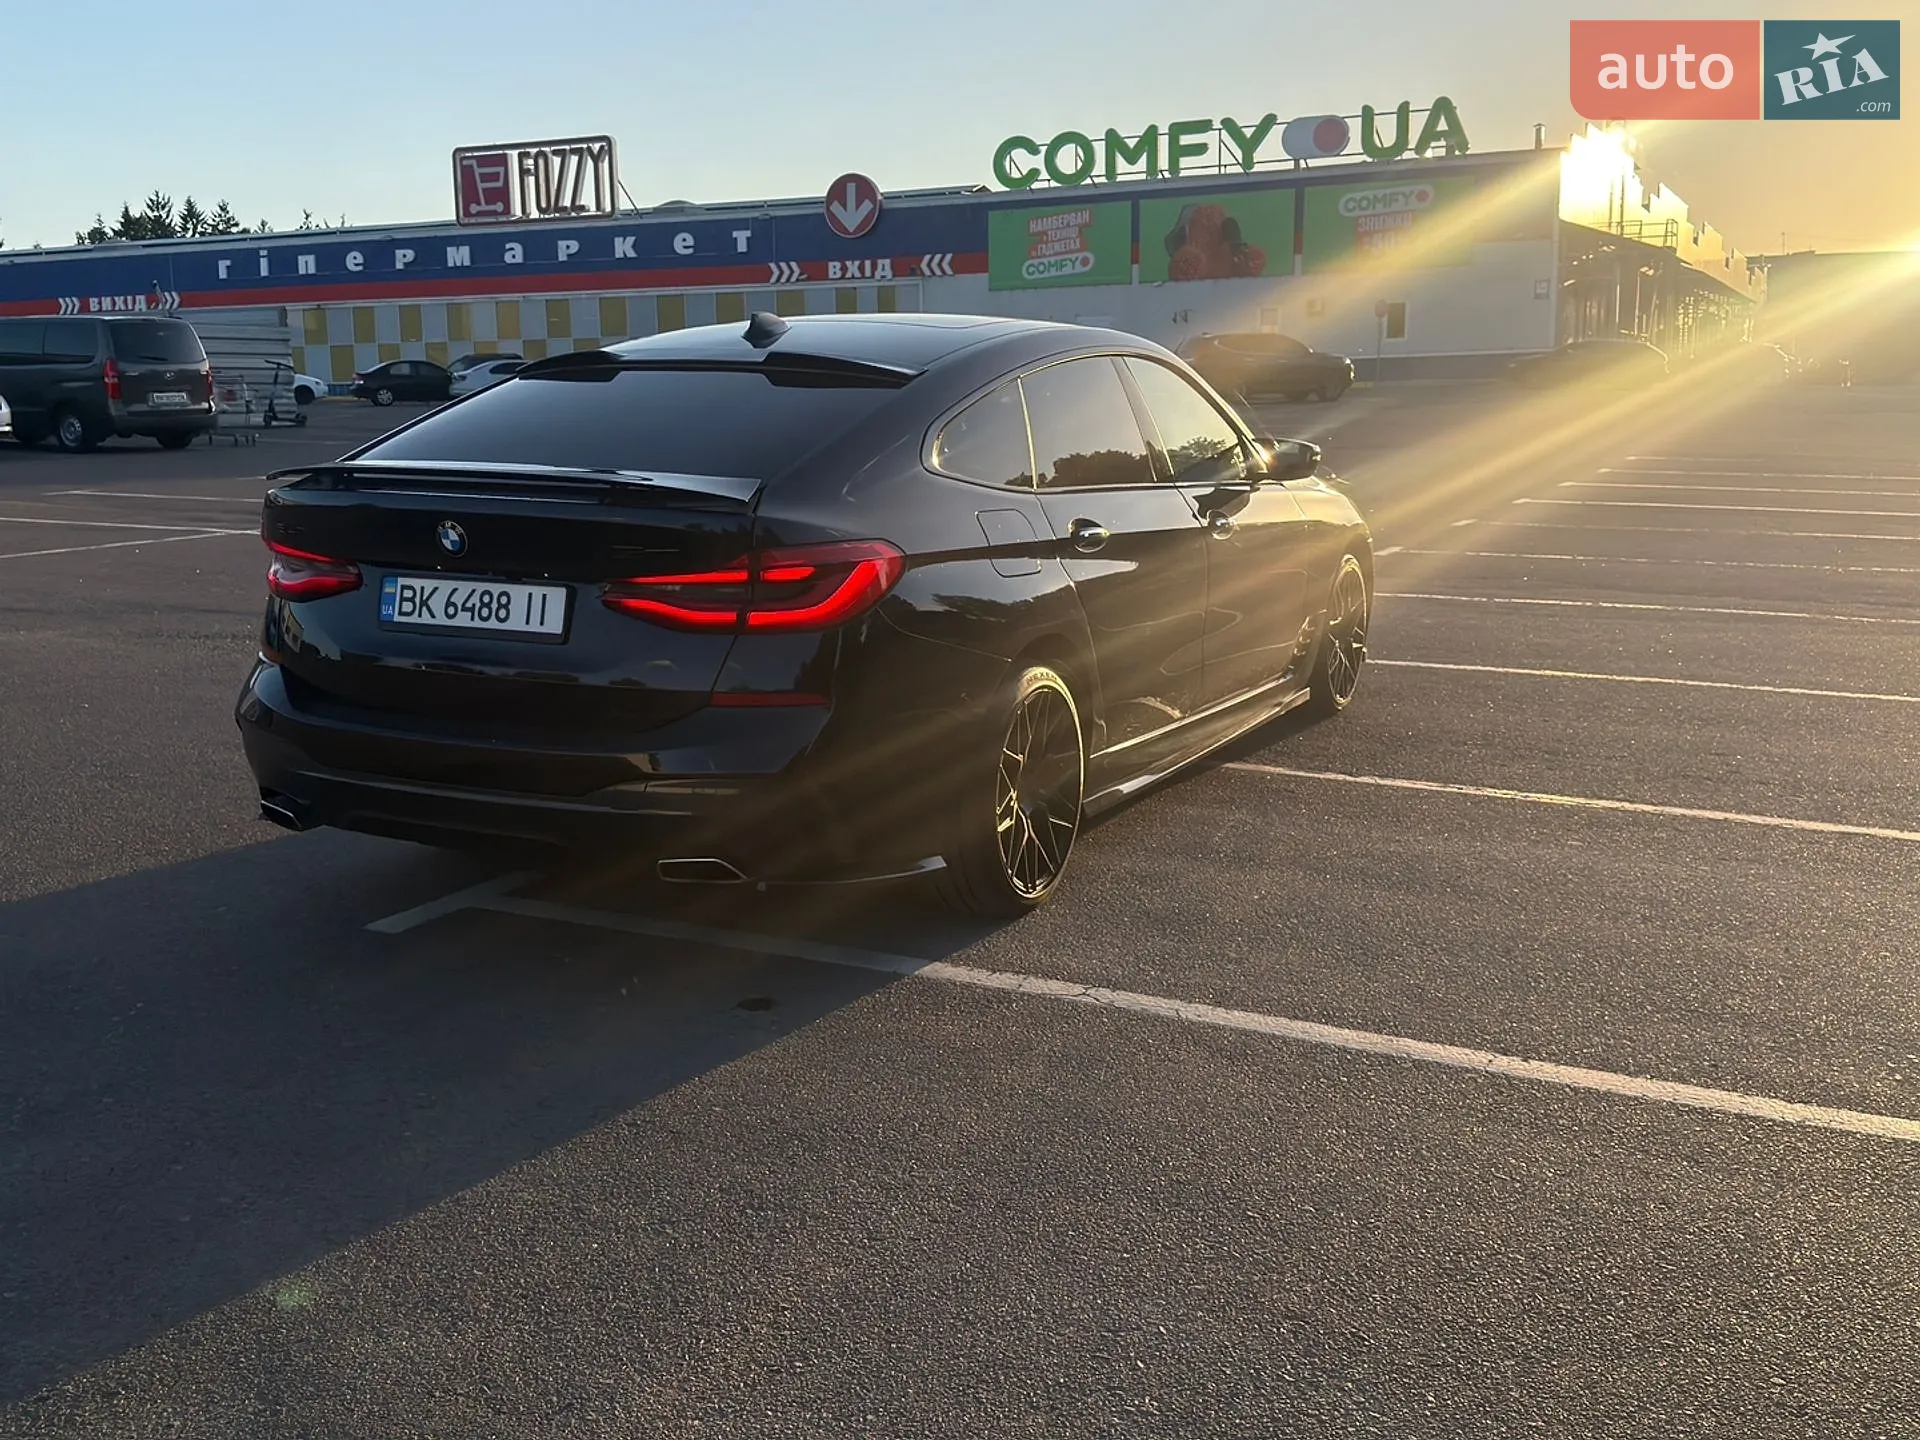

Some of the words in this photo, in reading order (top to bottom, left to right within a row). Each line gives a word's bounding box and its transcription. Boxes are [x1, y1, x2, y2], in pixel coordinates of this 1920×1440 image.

[992, 112, 1278, 189] COMFY
[1361, 96, 1470, 160] UA
[517, 144, 607, 215] FOZZY
[1344, 189, 1415, 213] COMFY
[1029, 209, 1090, 233] НАМБЕРВАН
[827, 258, 893, 280] ВХІД
[1025, 256, 1080, 276] COMFY
[89, 294, 147, 312] ВИХІД
[382, 604, 394, 615] UA
[397, 584, 439, 619] BK
[443, 587, 512, 624] 6488
